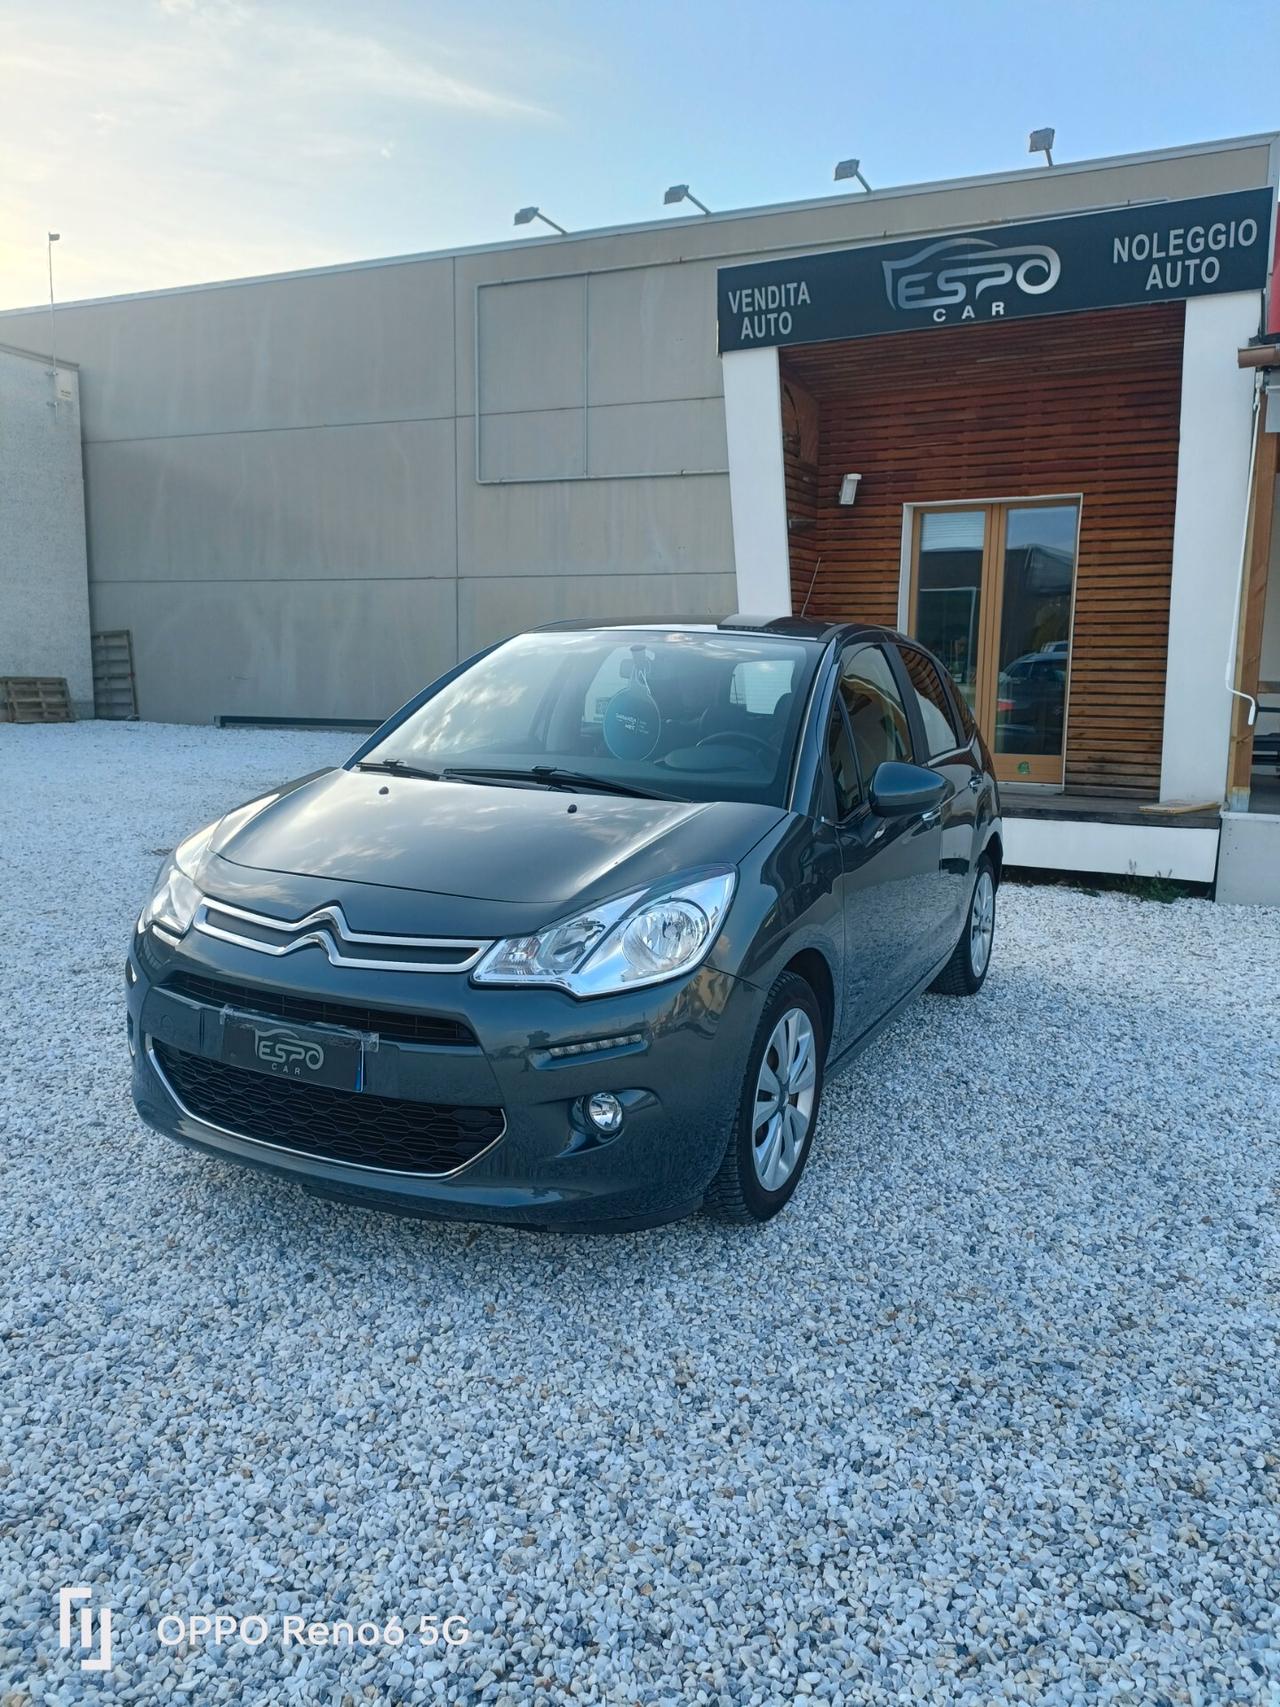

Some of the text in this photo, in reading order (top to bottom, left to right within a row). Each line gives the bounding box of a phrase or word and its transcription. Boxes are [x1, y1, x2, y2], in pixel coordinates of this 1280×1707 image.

[1113, 218, 1258, 264] NOLEGGIO
[897, 244, 1061, 309] ESPO
[1145, 256, 1220, 291] AUTO
[728, 281, 811, 314] VENDITA
[933, 301, 1005, 322] CAR
[741, 311, 792, 340] AUTO
[258, 1037, 324, 1070] ESPO
[271, 1062, 301, 1075] CAR
